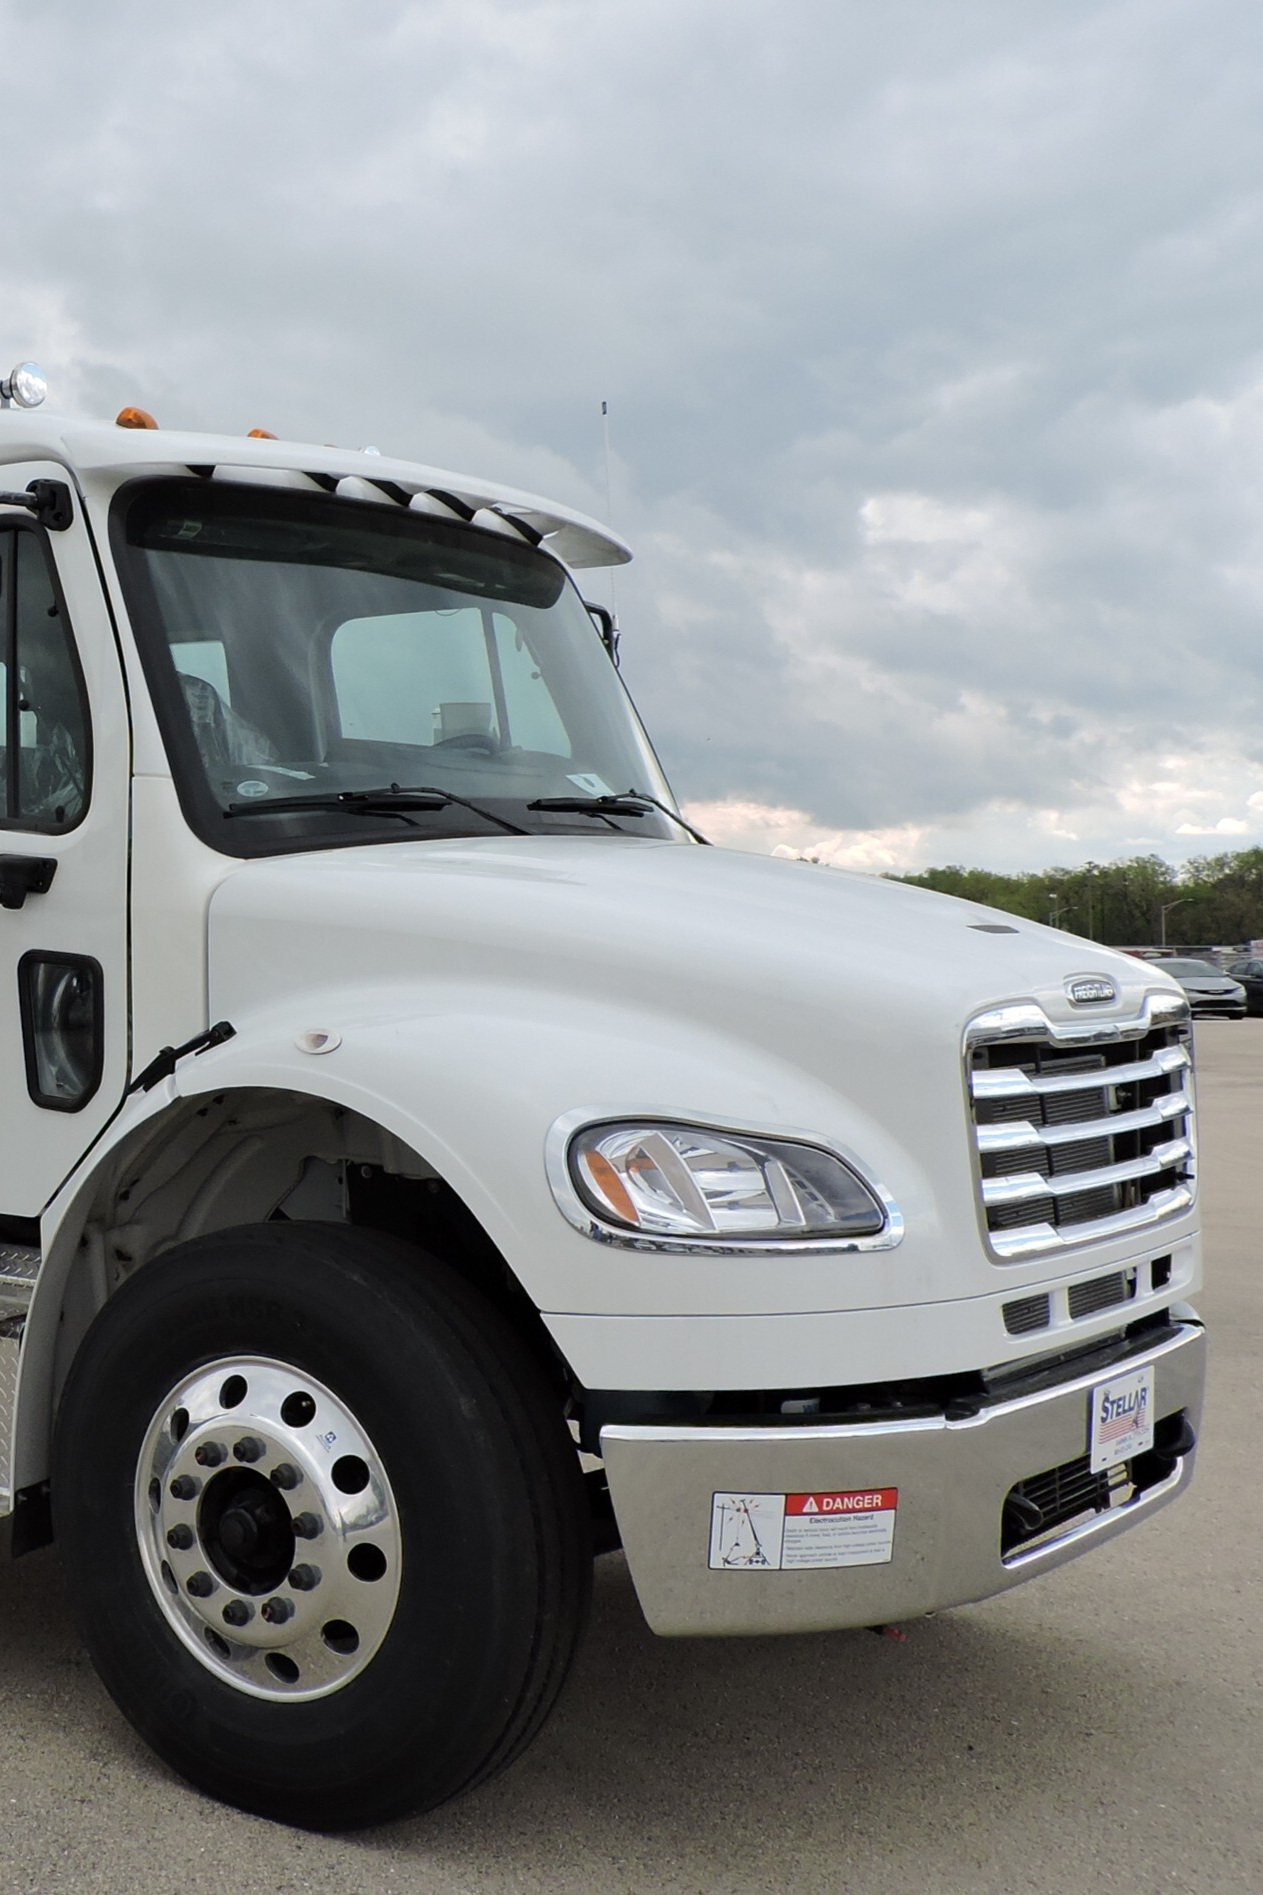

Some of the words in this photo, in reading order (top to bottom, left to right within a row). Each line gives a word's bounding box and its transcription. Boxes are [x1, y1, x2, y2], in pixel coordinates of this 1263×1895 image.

[1100, 1386, 1147, 1424] STELLAR
[823, 1494, 882, 1511] DANGER
[809, 1516, 852, 1525] Electrocution
[853, 1514, 874, 1523] Hazard
